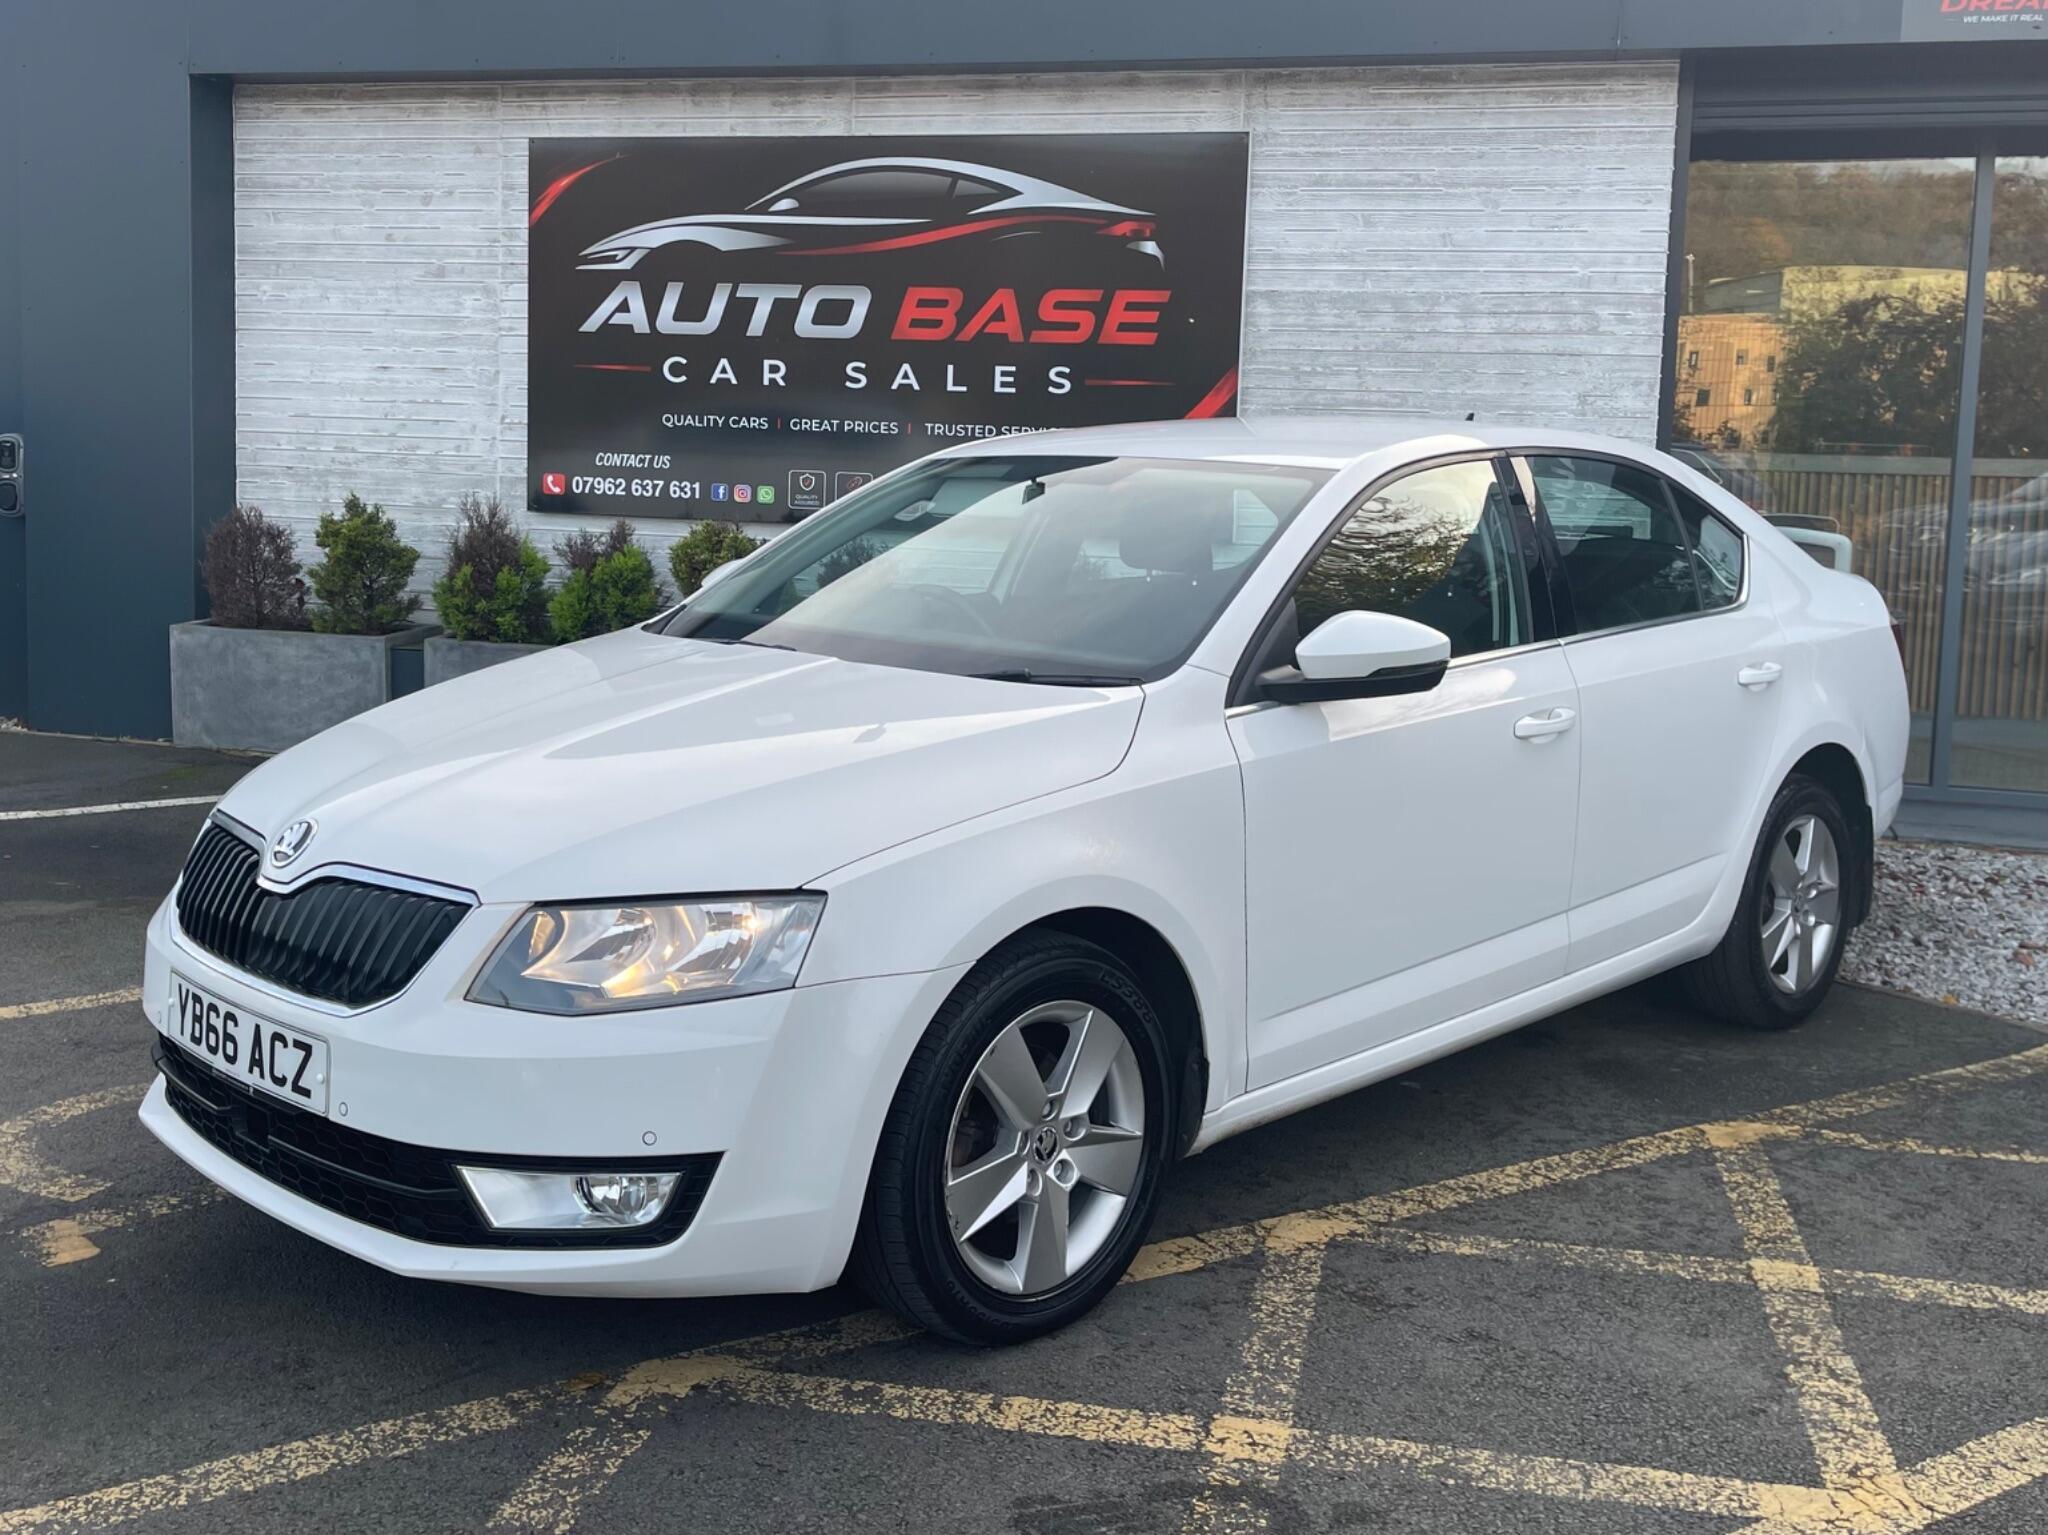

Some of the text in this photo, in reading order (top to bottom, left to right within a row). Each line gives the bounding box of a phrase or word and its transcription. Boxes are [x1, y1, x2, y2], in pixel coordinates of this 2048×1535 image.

[1963, 13, 2044, 24] WE MAKE IT REAL
[579, 280, 1171, 345] AUTO BASE
[662, 356, 1072, 394] CAR SALES
[661, 413, 769, 430] QUALITY CARS
[789, 418, 899, 435] GREAT PRICES
[925, 422, 996, 437] TRUSTED
[595, 451, 672, 469] CONTACT US
[571, 475, 701, 499] 07962 637 631
[178, 982, 314, 1100] YB66 ACZ
